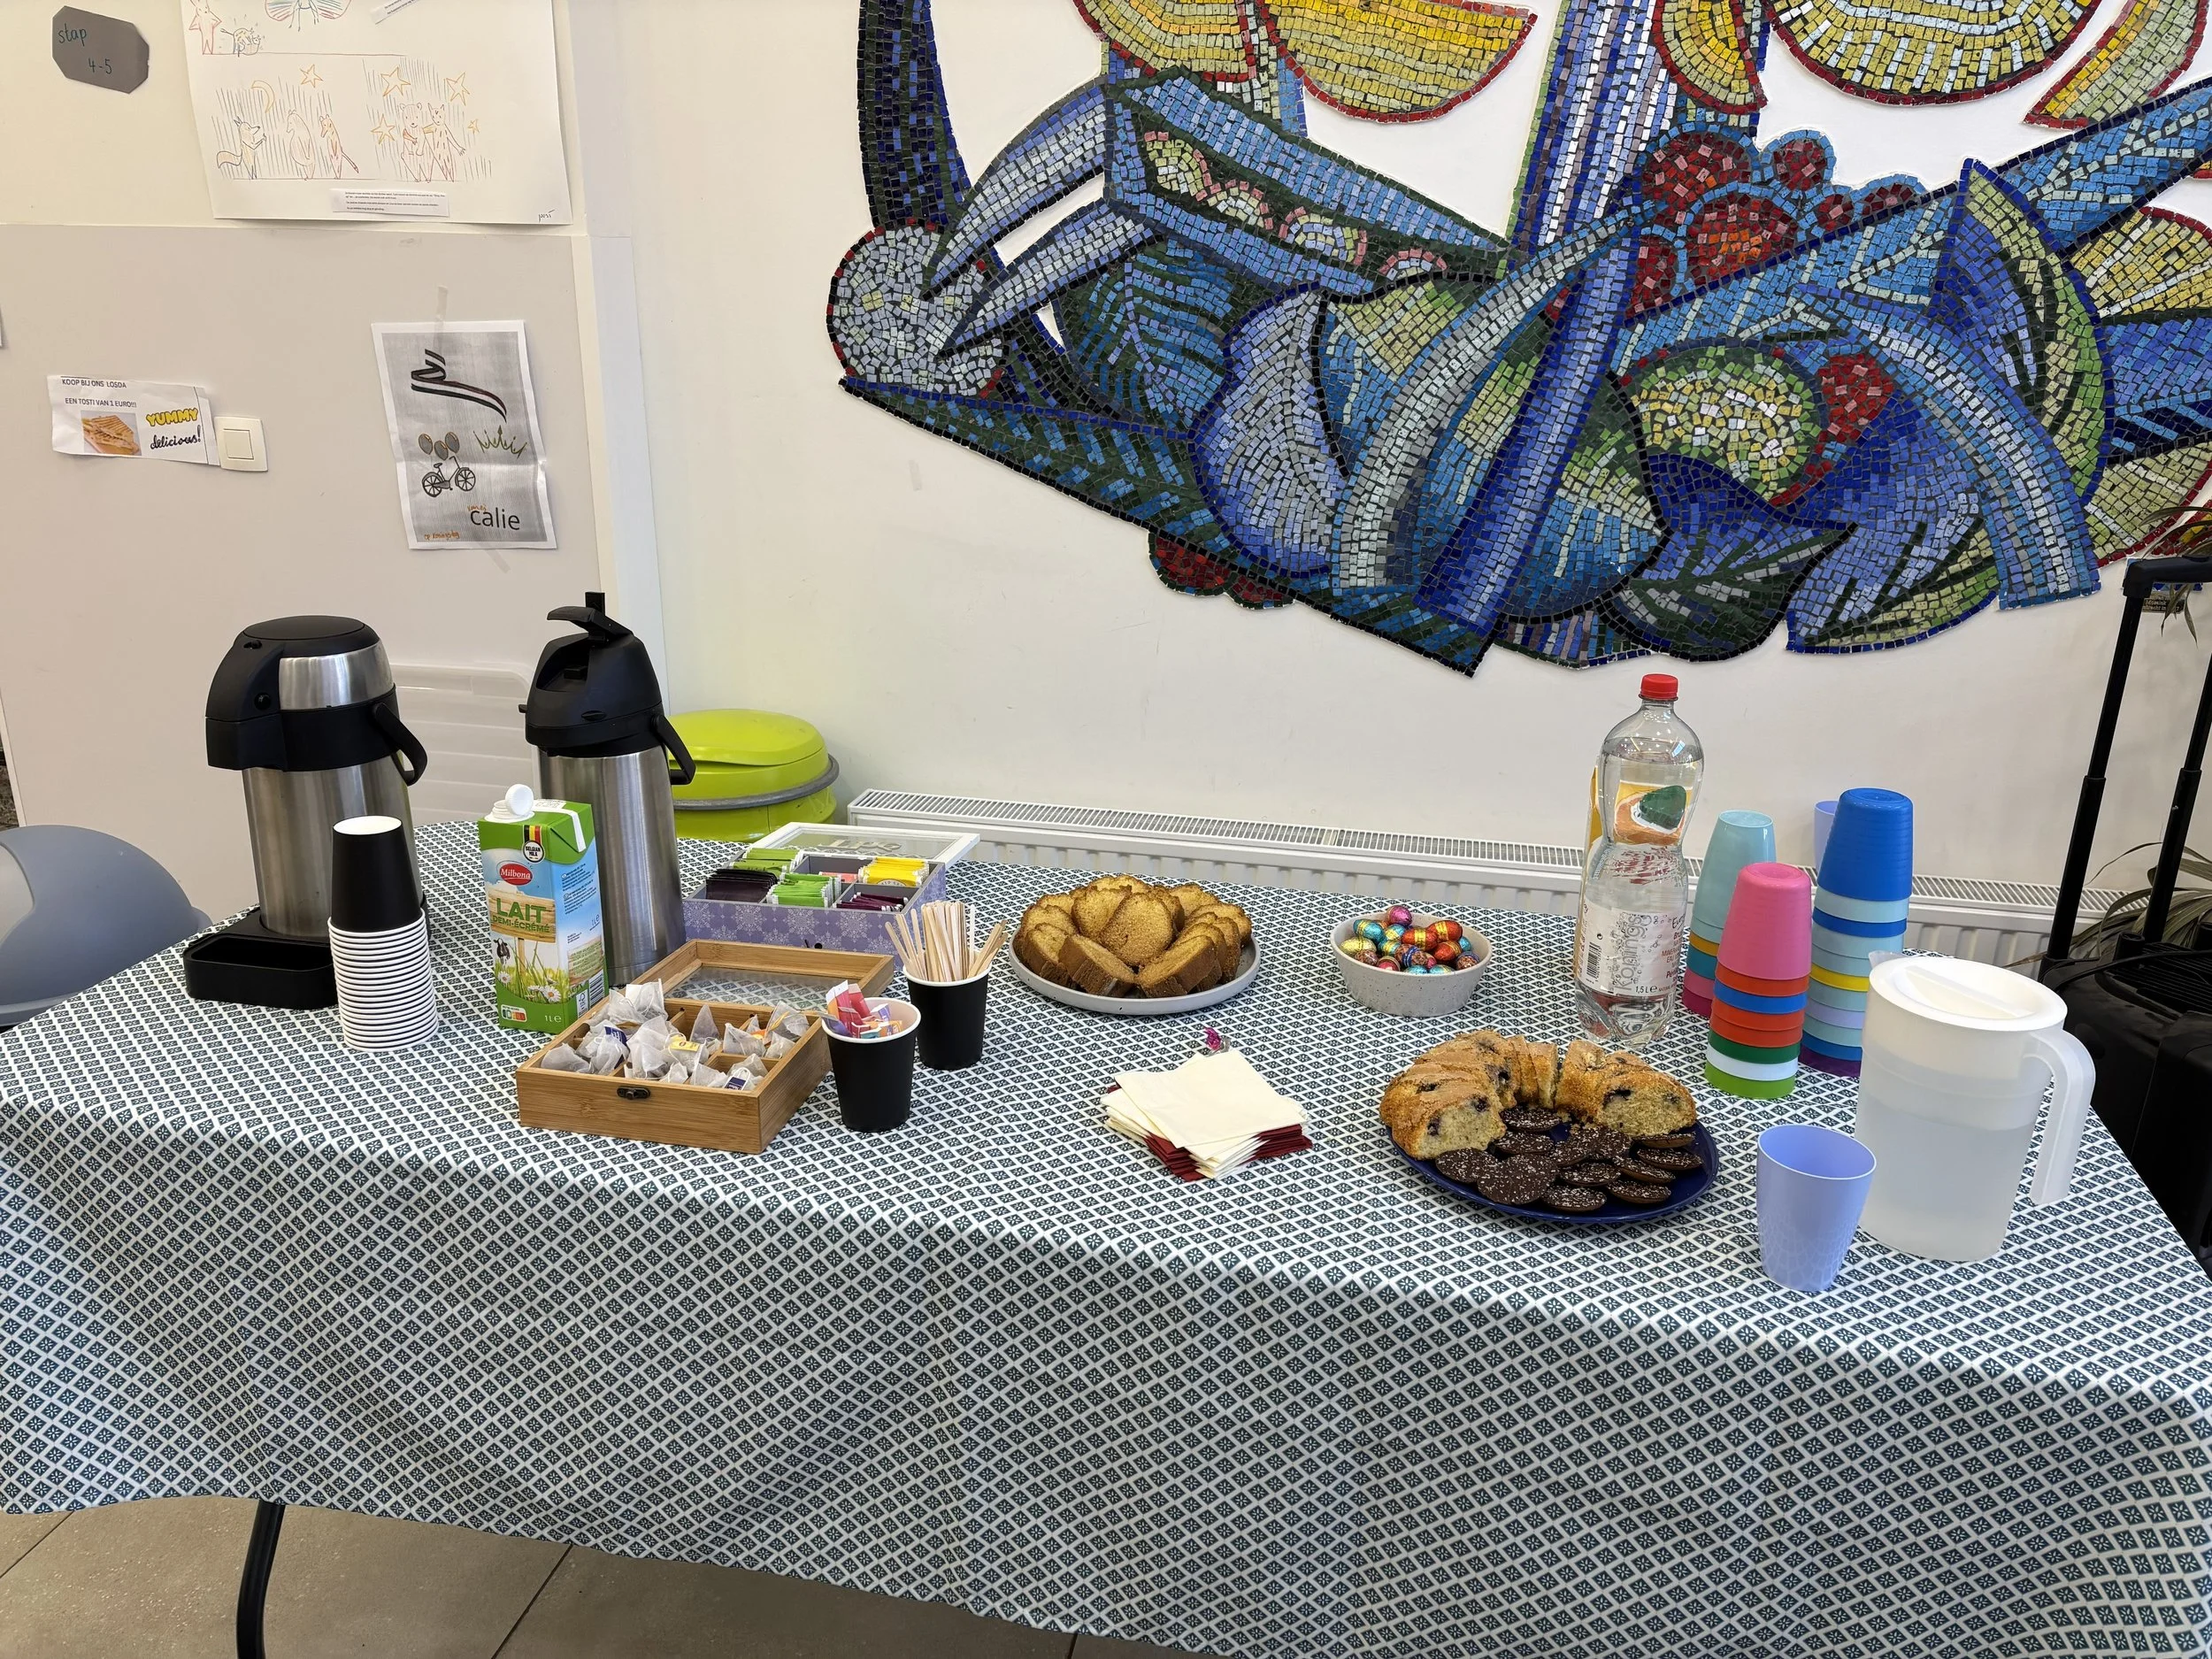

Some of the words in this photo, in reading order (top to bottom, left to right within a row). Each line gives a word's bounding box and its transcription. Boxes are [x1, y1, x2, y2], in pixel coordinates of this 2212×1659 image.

[58, 23, 87, 46] stap
[88, 58, 112, 74] 4-5
[146, 407, 198, 426] YUMMY
[150, 425, 201, 449] delicious!
[470, 506, 520, 531] calie
[500, 868, 531, 879] Milbona
[496, 897, 547, 924] LAIT
[492, 915, 550, 933] DEMI-ÉCRÉMÉ
